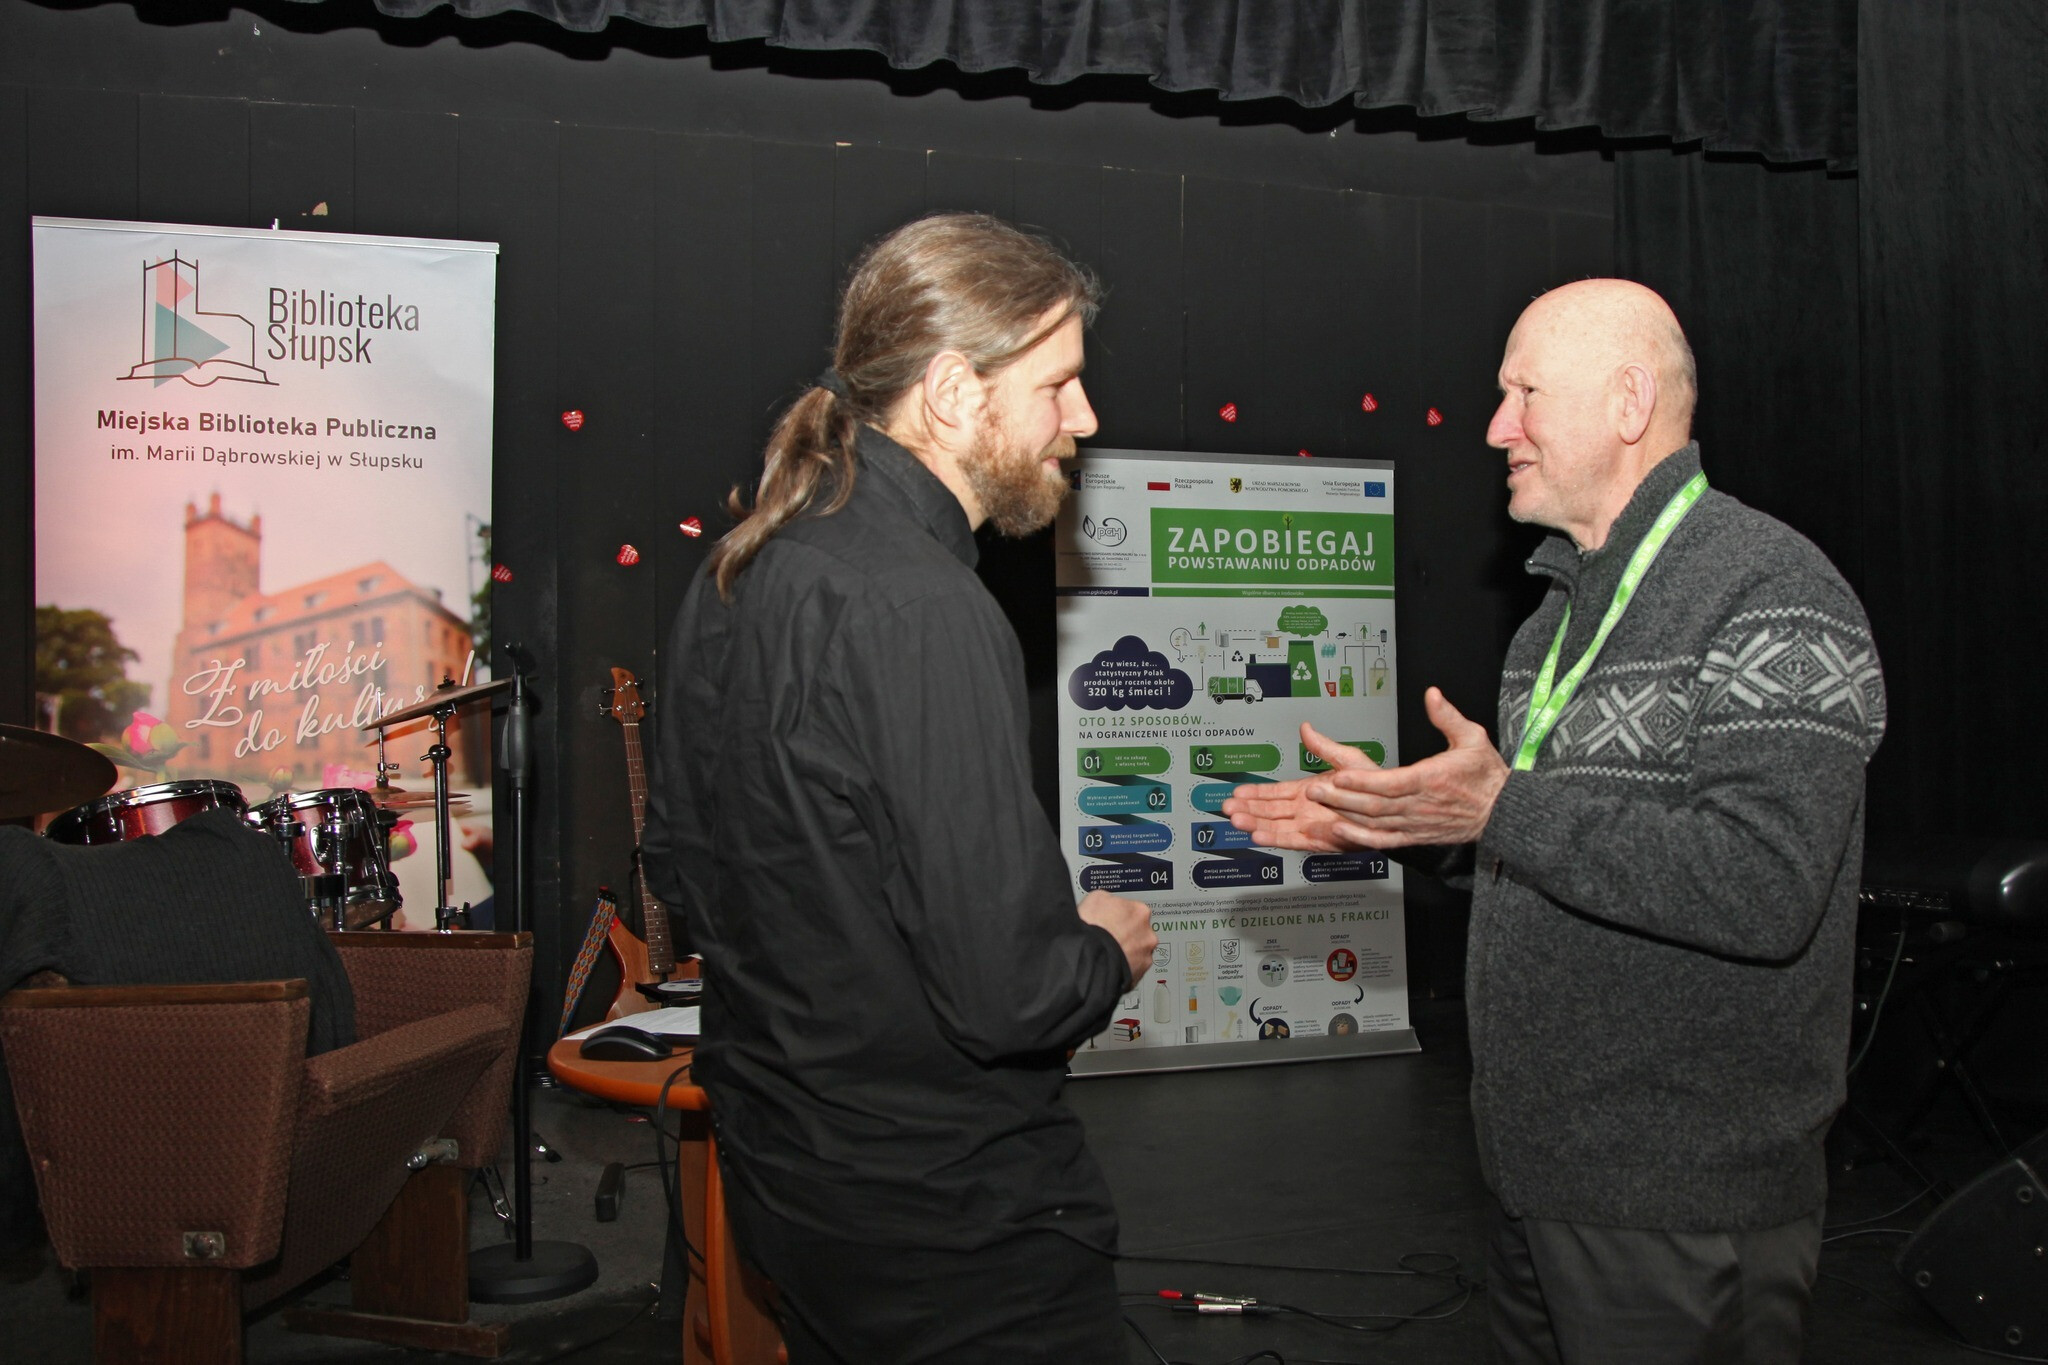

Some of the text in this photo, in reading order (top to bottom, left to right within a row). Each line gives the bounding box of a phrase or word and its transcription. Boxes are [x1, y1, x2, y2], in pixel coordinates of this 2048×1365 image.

[269, 287, 420, 331] Biblioteka
[268, 324, 372, 369] Słupsk
[97, 410, 438, 441] Miejska Biblioteka Publiczna
[111, 445, 424, 473] im. Marii Dąbrowskiej w Słupsku
[1168, 527, 1374, 556] ZAPOBIEGAJ
[1168, 556, 1376, 572] POWSTAWANIU ODPADÓW
[183, 640, 386, 728] Z miłości
[1084, 679, 1122, 687] produkuje
[1088, 688, 1107, 696] 320
[1112, 688, 1124, 698] kg
[1128, 687, 1163, 696] śmieci
[1079, 716, 1106, 727] OTO
[1111, 717, 1125, 726] 12
[235, 710, 287, 759] do
[1079, 727, 1255, 739] NA OGRANICZENIE ILOŚCI ODPADÓW
[1084, 756, 1100, 769] 01
[1196, 754, 1213, 767] 05
[1149, 793, 1166, 806] 02
[1085, 835, 1103, 848] 03
[1198, 830, 1214, 843] 07
[1261, 866, 1279, 879] 08
[1369, 861, 1384, 874] 12
[1151, 871, 1168, 884] 04
[1151, 910, 1389, 932] OWINNY BYĆ DZIELONE NA 5 FRAKCJI
